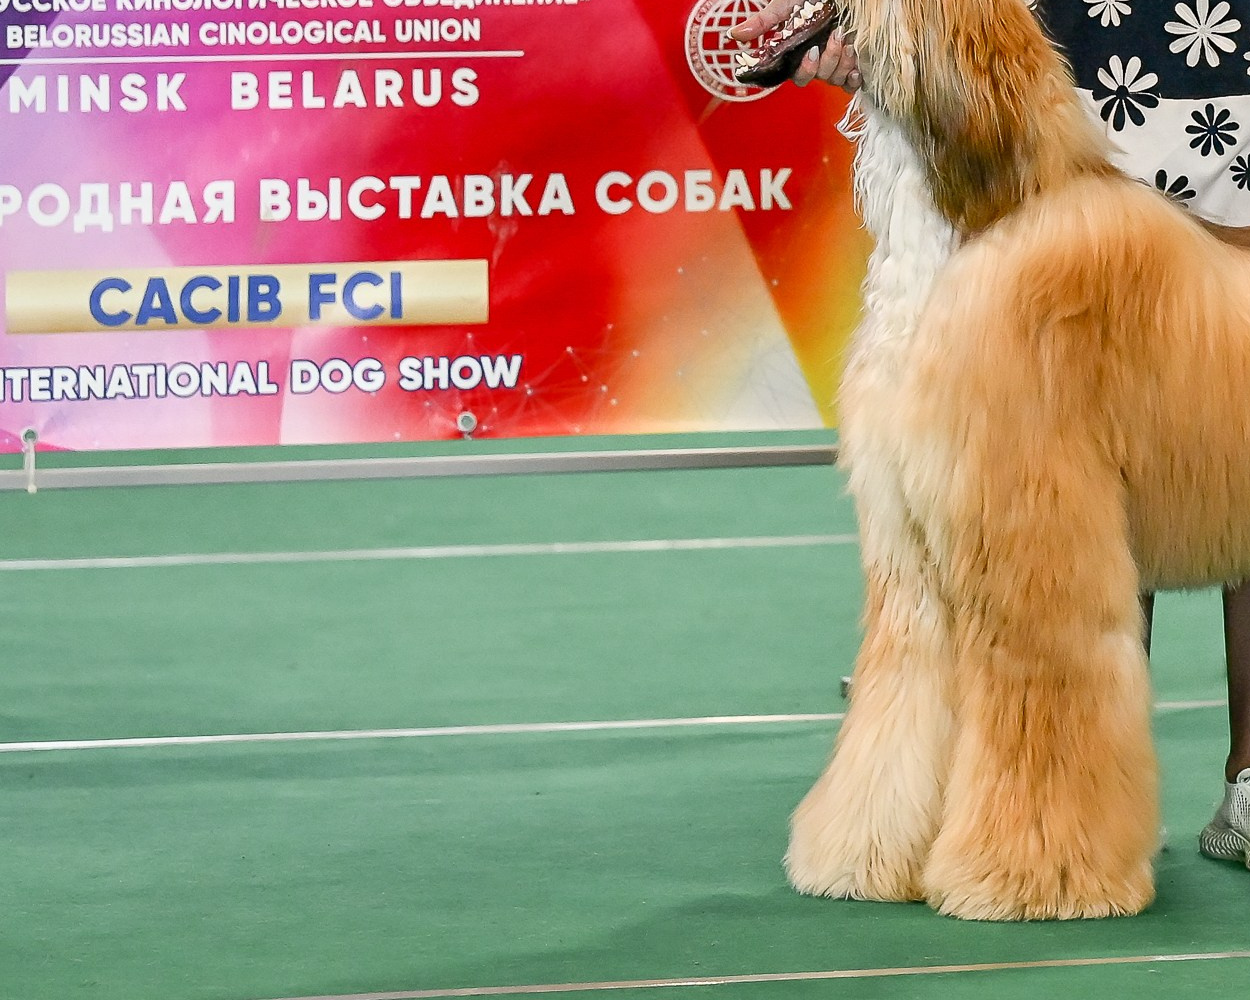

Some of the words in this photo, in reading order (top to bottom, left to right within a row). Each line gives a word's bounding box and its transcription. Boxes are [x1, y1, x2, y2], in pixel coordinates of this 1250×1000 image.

[6, 22, 191, 49] BELORUSSIAN
[199, 19, 387, 47] CINOLOGICAL
[394, 17, 482, 43] UNION
[8, 72, 188, 114] MINSK
[231, 67, 481, 111] BELARUS
[0, 179, 237, 233] РОДНАЯ
[258, 172, 576, 222] ВЫСТАВКА
[594, 168, 793, 215] СОБАК
[89, 273, 283, 327] CACIB
[307, 270, 404, 321] FCI
[0, 361, 280, 403] TERNATIONAL
[290, 356, 387, 394] DOG
[398, 353, 524, 391] SHOW
